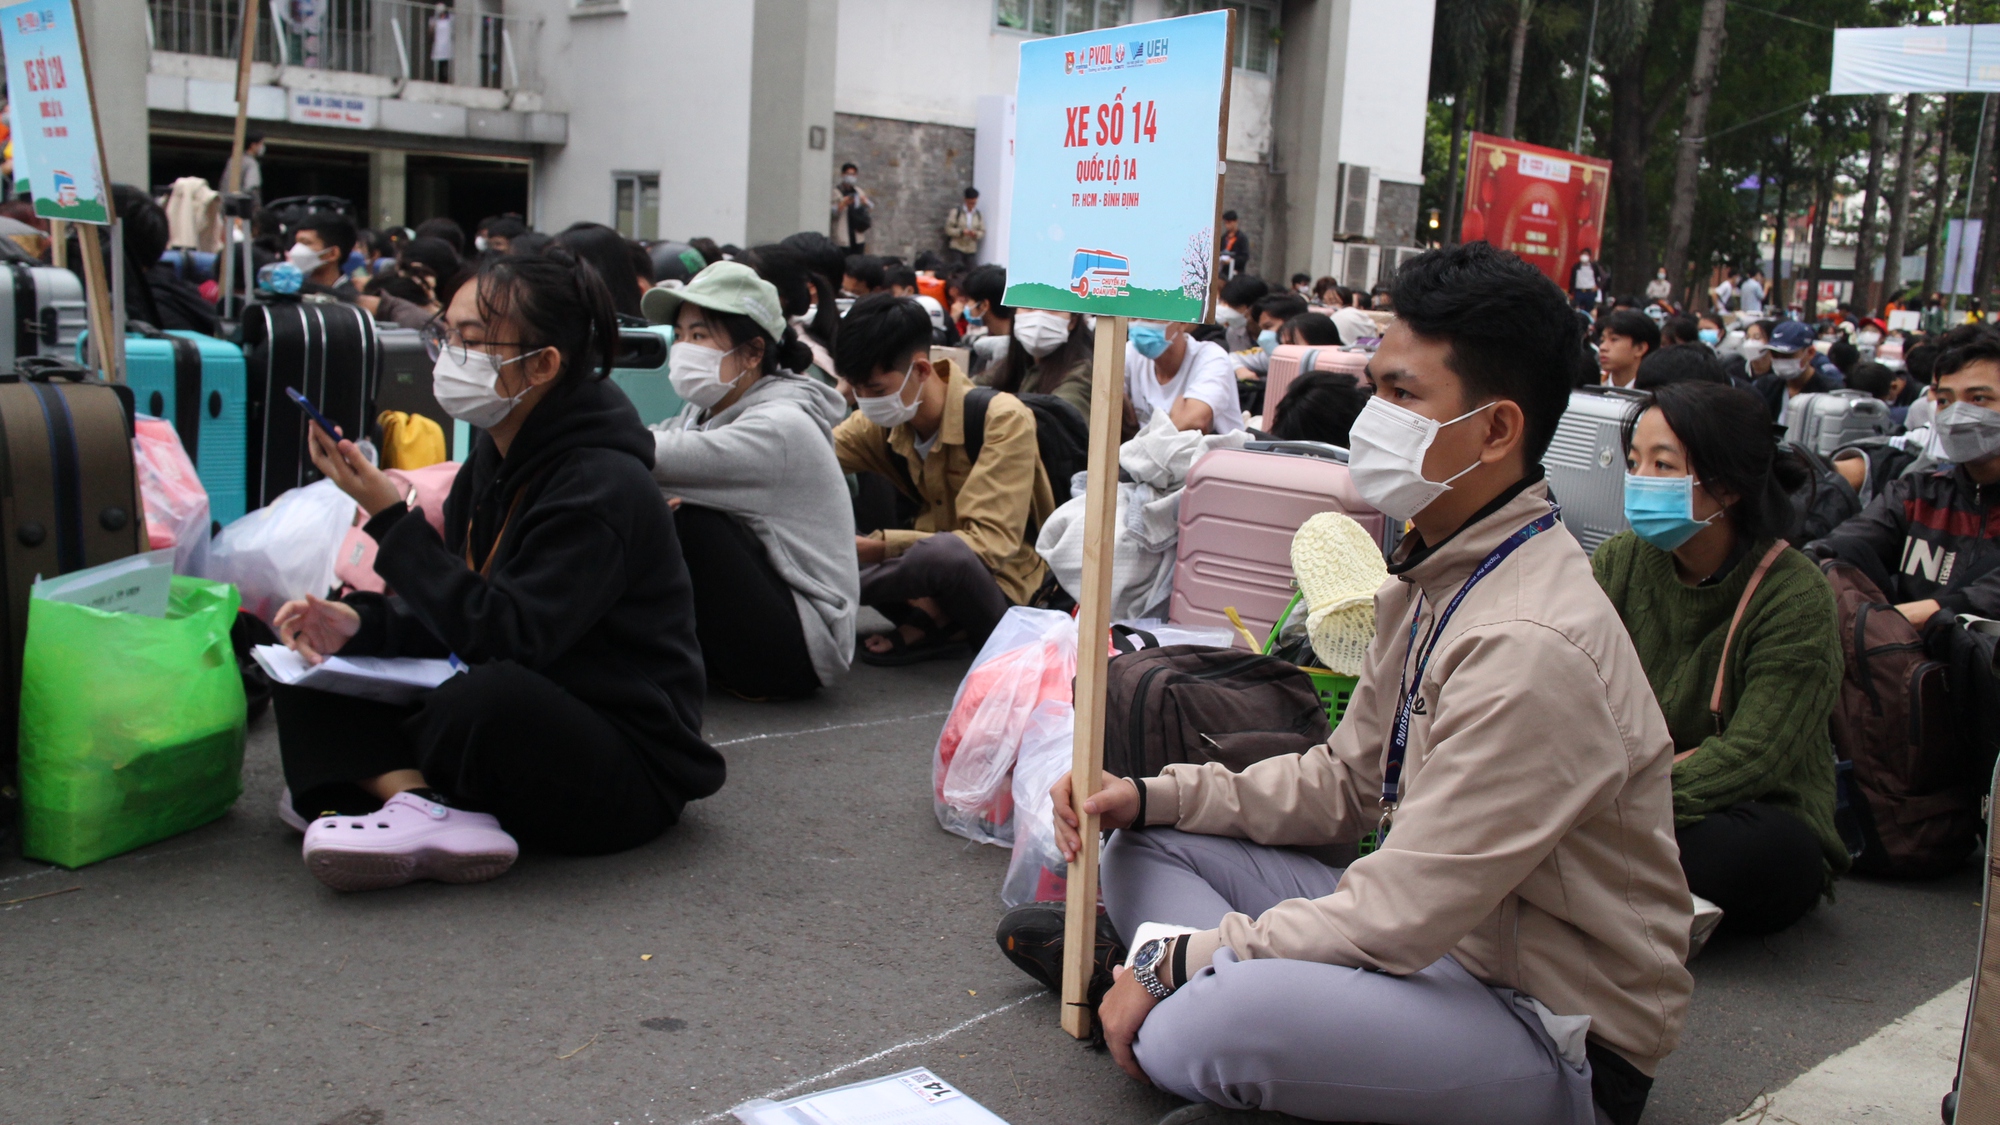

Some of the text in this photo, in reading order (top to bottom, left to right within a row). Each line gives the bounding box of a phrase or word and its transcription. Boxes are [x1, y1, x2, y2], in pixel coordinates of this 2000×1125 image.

[1089, 44, 1113, 66] PVOIL
[1147, 38, 1169, 58] UEH
[1146, 56, 1168, 65] UNIVERSITY
[1063, 105, 1090, 148] XE
[1095, 86, 1127, 146] SỐ
[1132, 100, 1157, 144] 14
[1076, 152, 1137, 186] QUỐC LỘ 1A
[1072, 193, 1080, 207] TP.
[1082, 193, 1097, 207] HCM
[1103, 190, 1120, 207] BÌNH
[1121, 192, 1139, 210] ĐỊNH
[1938, 551, 1957, 586] YOURSELF
[1396, 693, 1413, 747] SAMSUNG
[923, 1081, 952, 1098] 14
